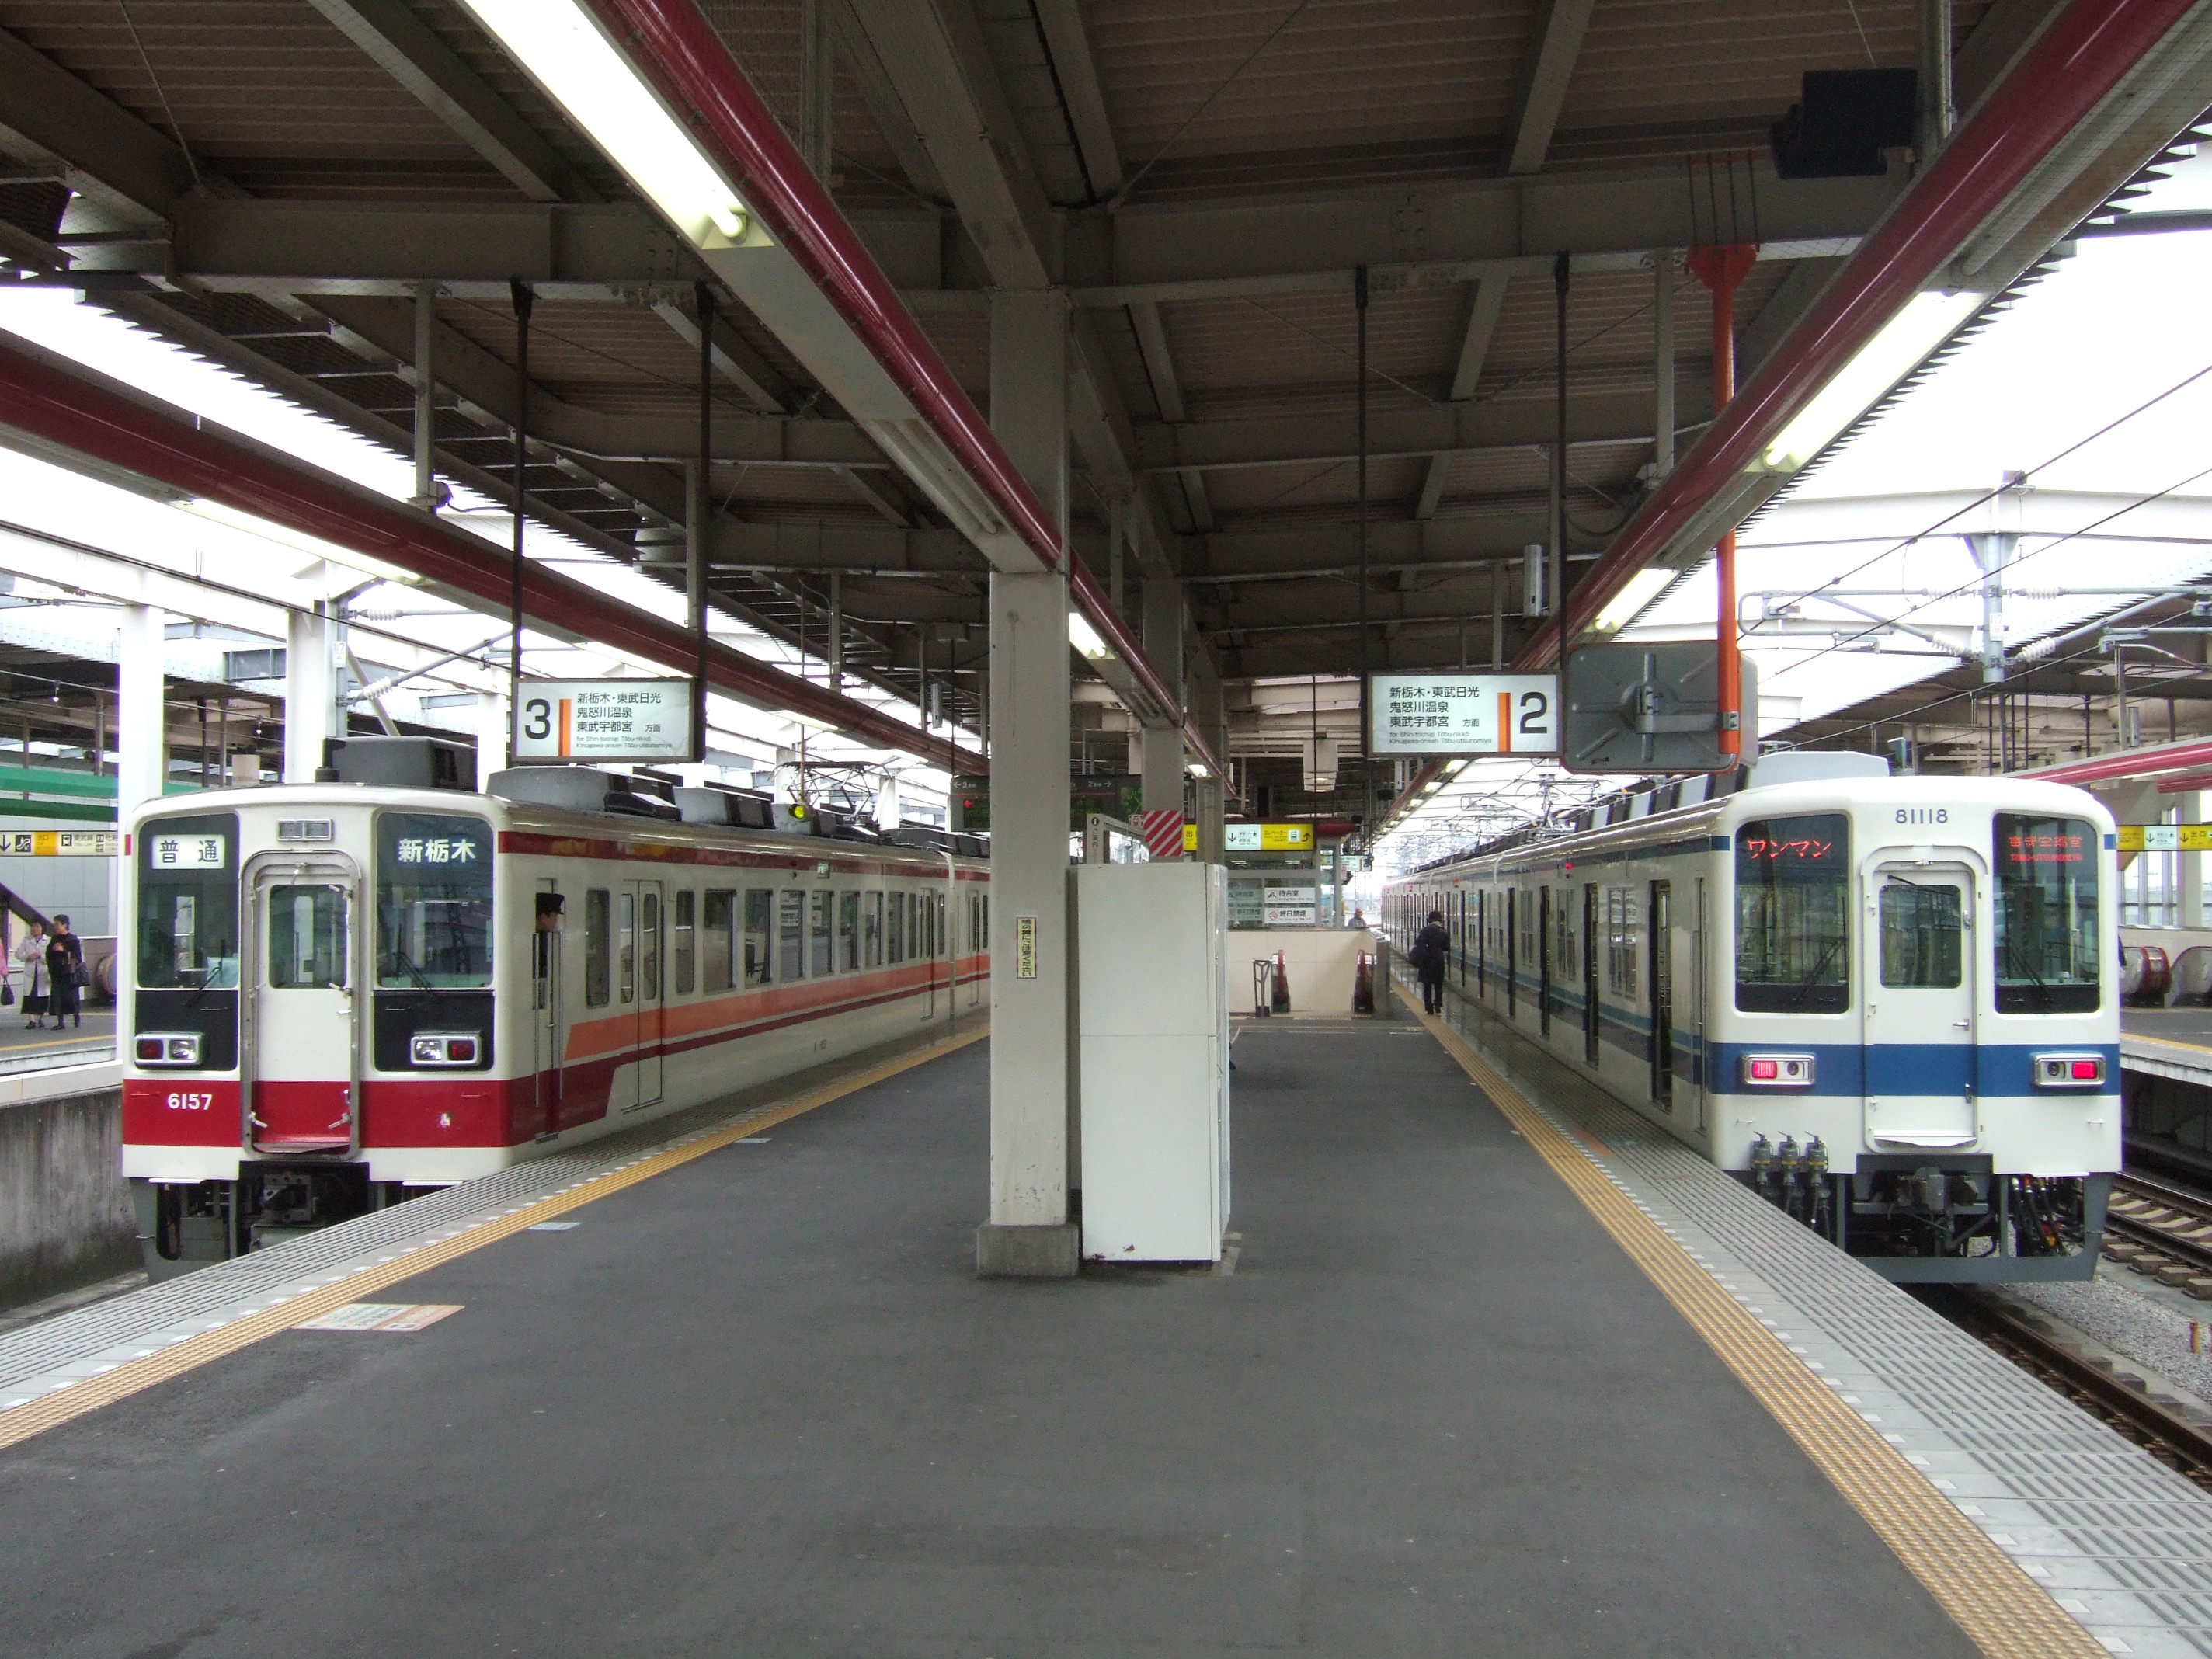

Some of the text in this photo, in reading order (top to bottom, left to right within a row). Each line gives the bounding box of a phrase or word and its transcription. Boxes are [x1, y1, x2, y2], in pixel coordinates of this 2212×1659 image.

[578, 693, 662, 704] 新栃木・東武日光
[1389, 687, 1480, 698] 新栃木・東武日光
[577, 706, 633, 718] 鬼怒川温泉
[1389, 701, 1449, 713] 鬼怒川温泉
[1519, 691, 1548, 734] 2
[524, 698, 551, 739] 3
[577, 721, 661, 732] 東武宇都宮 方面
[1389, 716, 1480, 728] 東武宇都宮 方面
[1895, 809, 1948, 825] 81118
[159, 840, 219, 863] 普通
[398, 838, 477, 863] 新栃木
[1747, 840, 1832, 859] ワンマン
[167, 1093, 213, 1110] 6157
